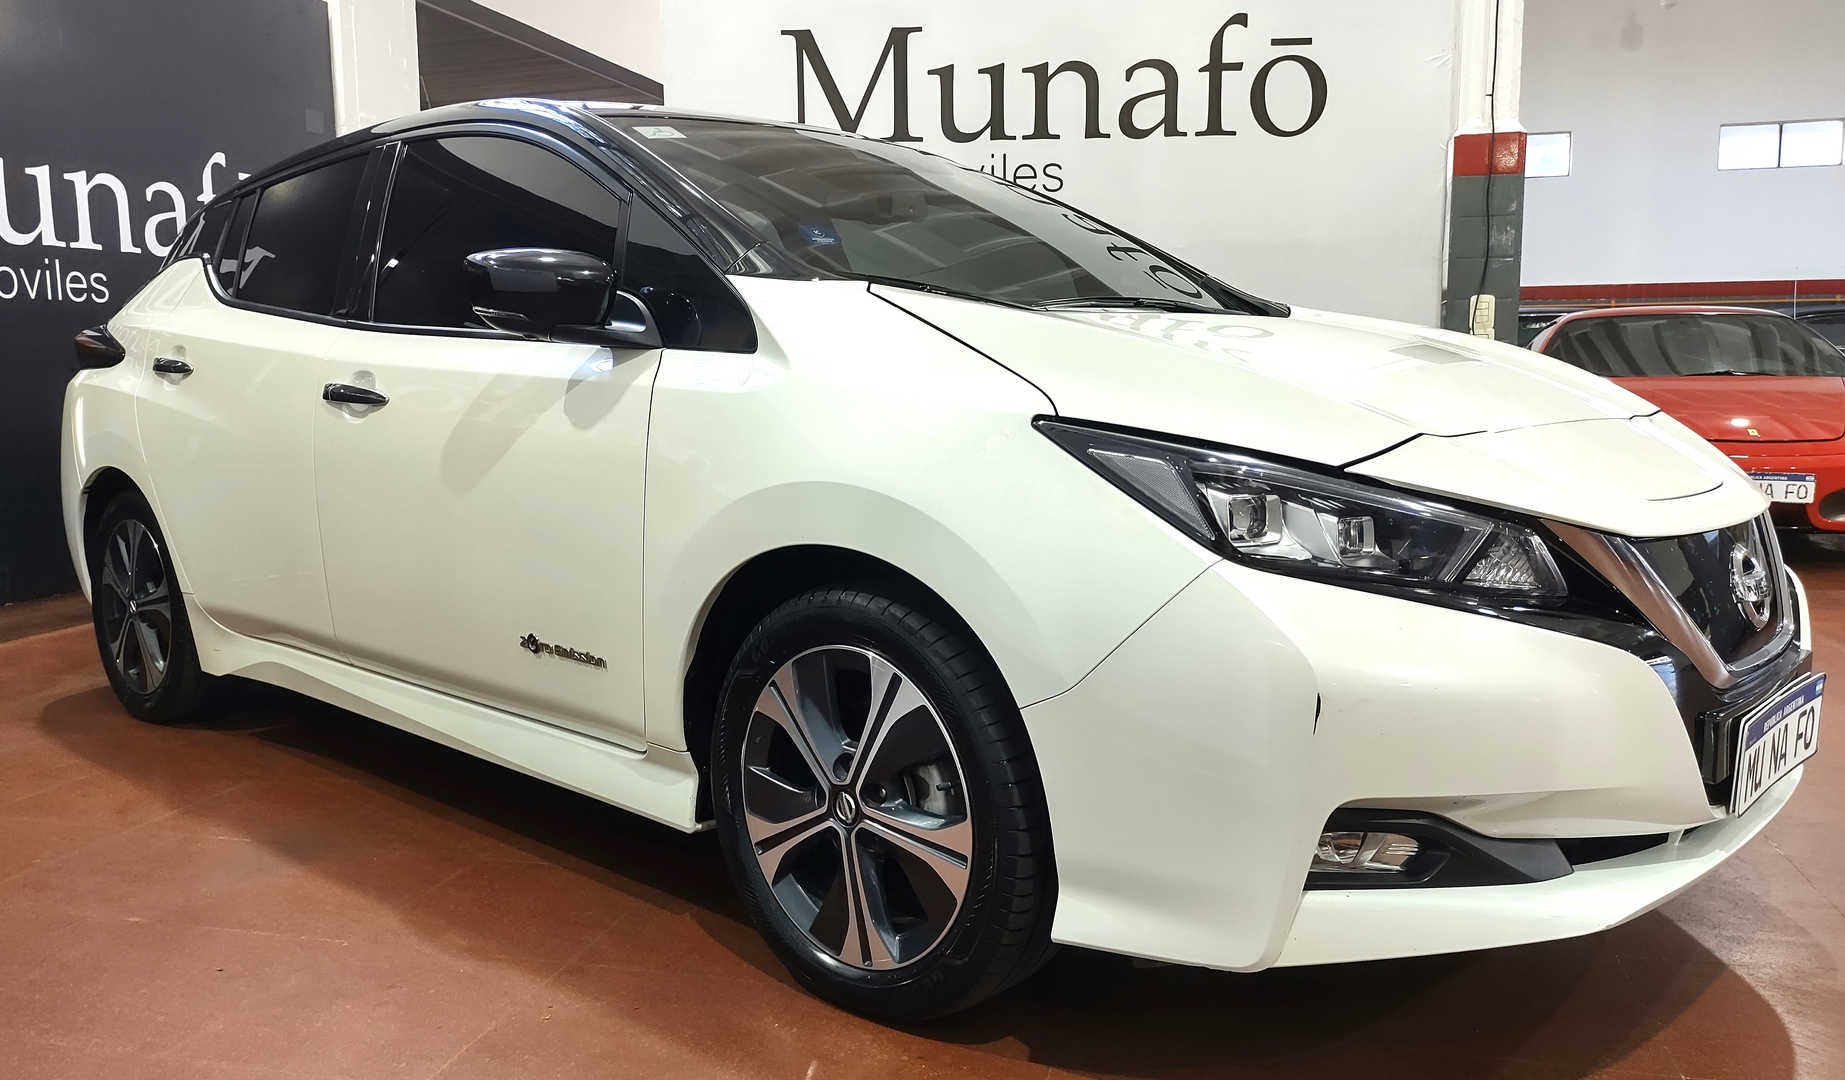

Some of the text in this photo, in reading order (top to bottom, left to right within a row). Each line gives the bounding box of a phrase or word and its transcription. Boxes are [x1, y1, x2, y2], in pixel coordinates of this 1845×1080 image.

[781, 13, 1328, 144] Munafō
[980, 153, 1064, 193] iles
[1744, 706, 1815, 803] MU NA FO
